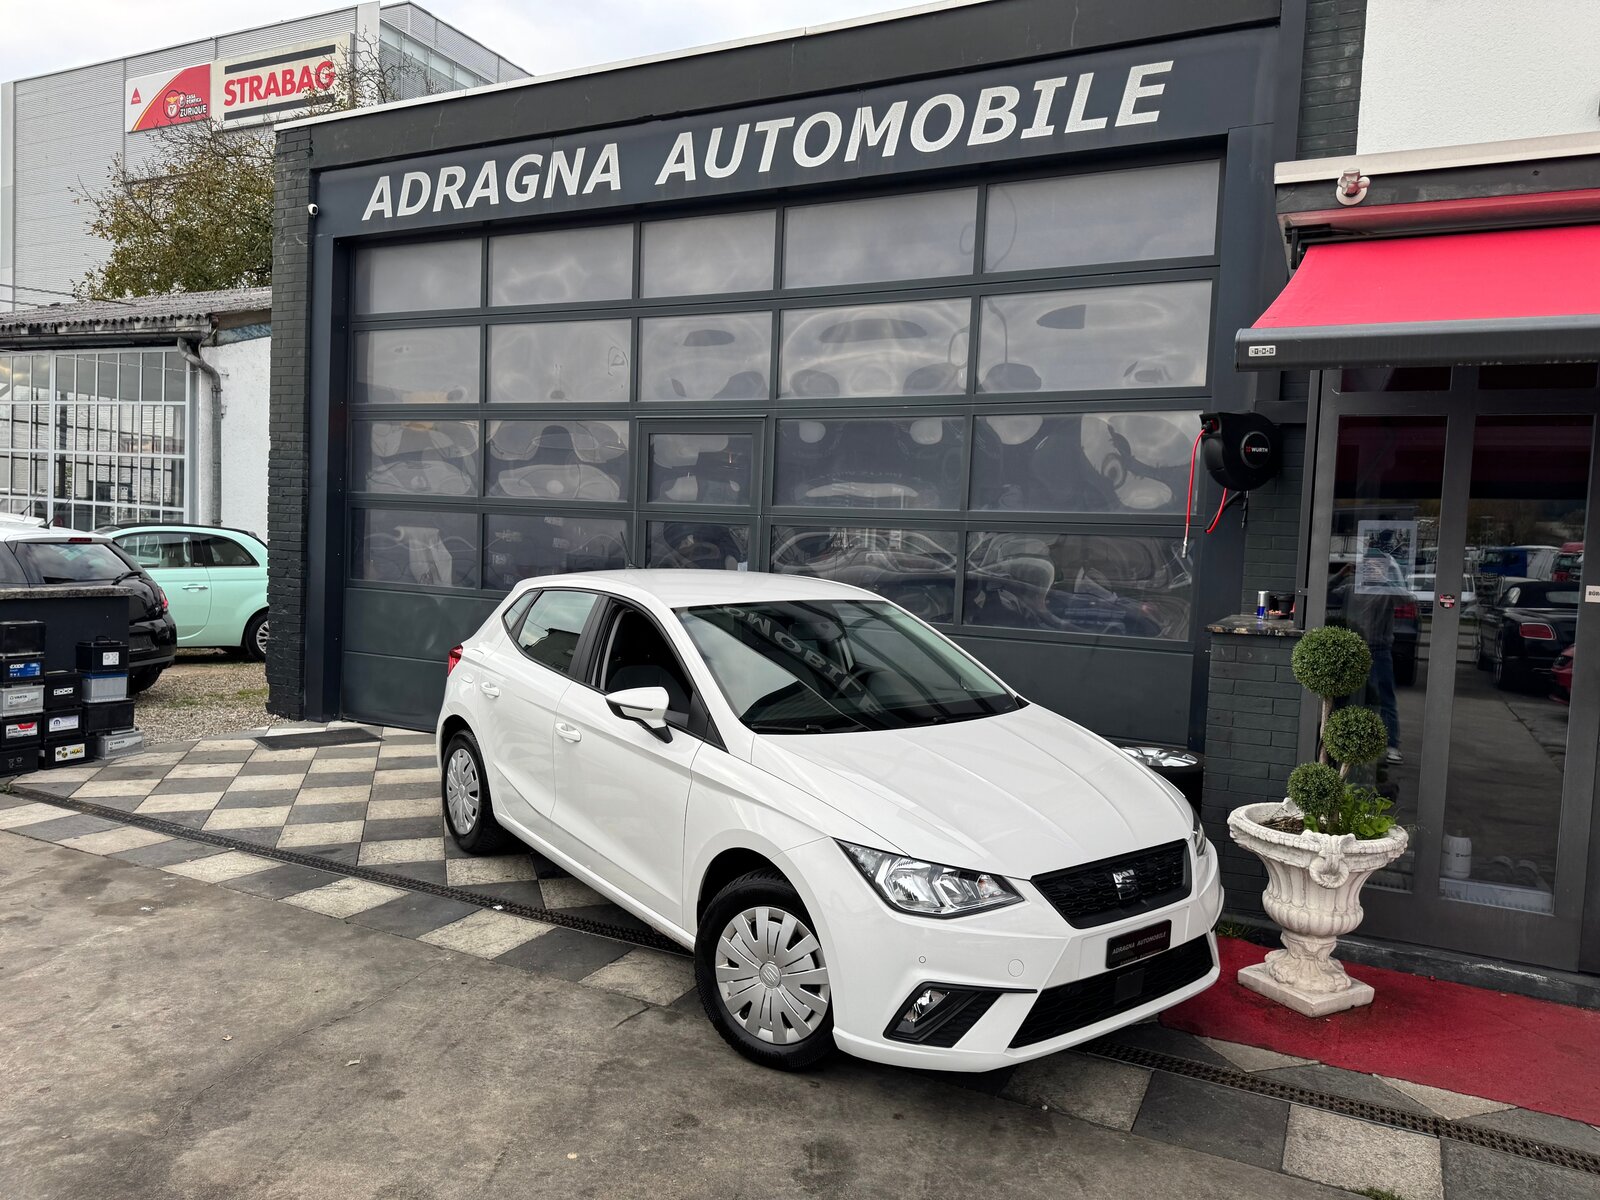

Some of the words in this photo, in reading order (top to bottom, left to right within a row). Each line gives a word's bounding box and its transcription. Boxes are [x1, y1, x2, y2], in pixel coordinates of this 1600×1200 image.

[223, 60, 335, 107] STRABAG
[180, 104, 207, 117] ZURIQUE
[361, 142, 622, 221] ADRAGNA
[654, 60, 1174, 186] AUTOMOBILE
[1111, 942, 1135, 955] ADRAGNA
